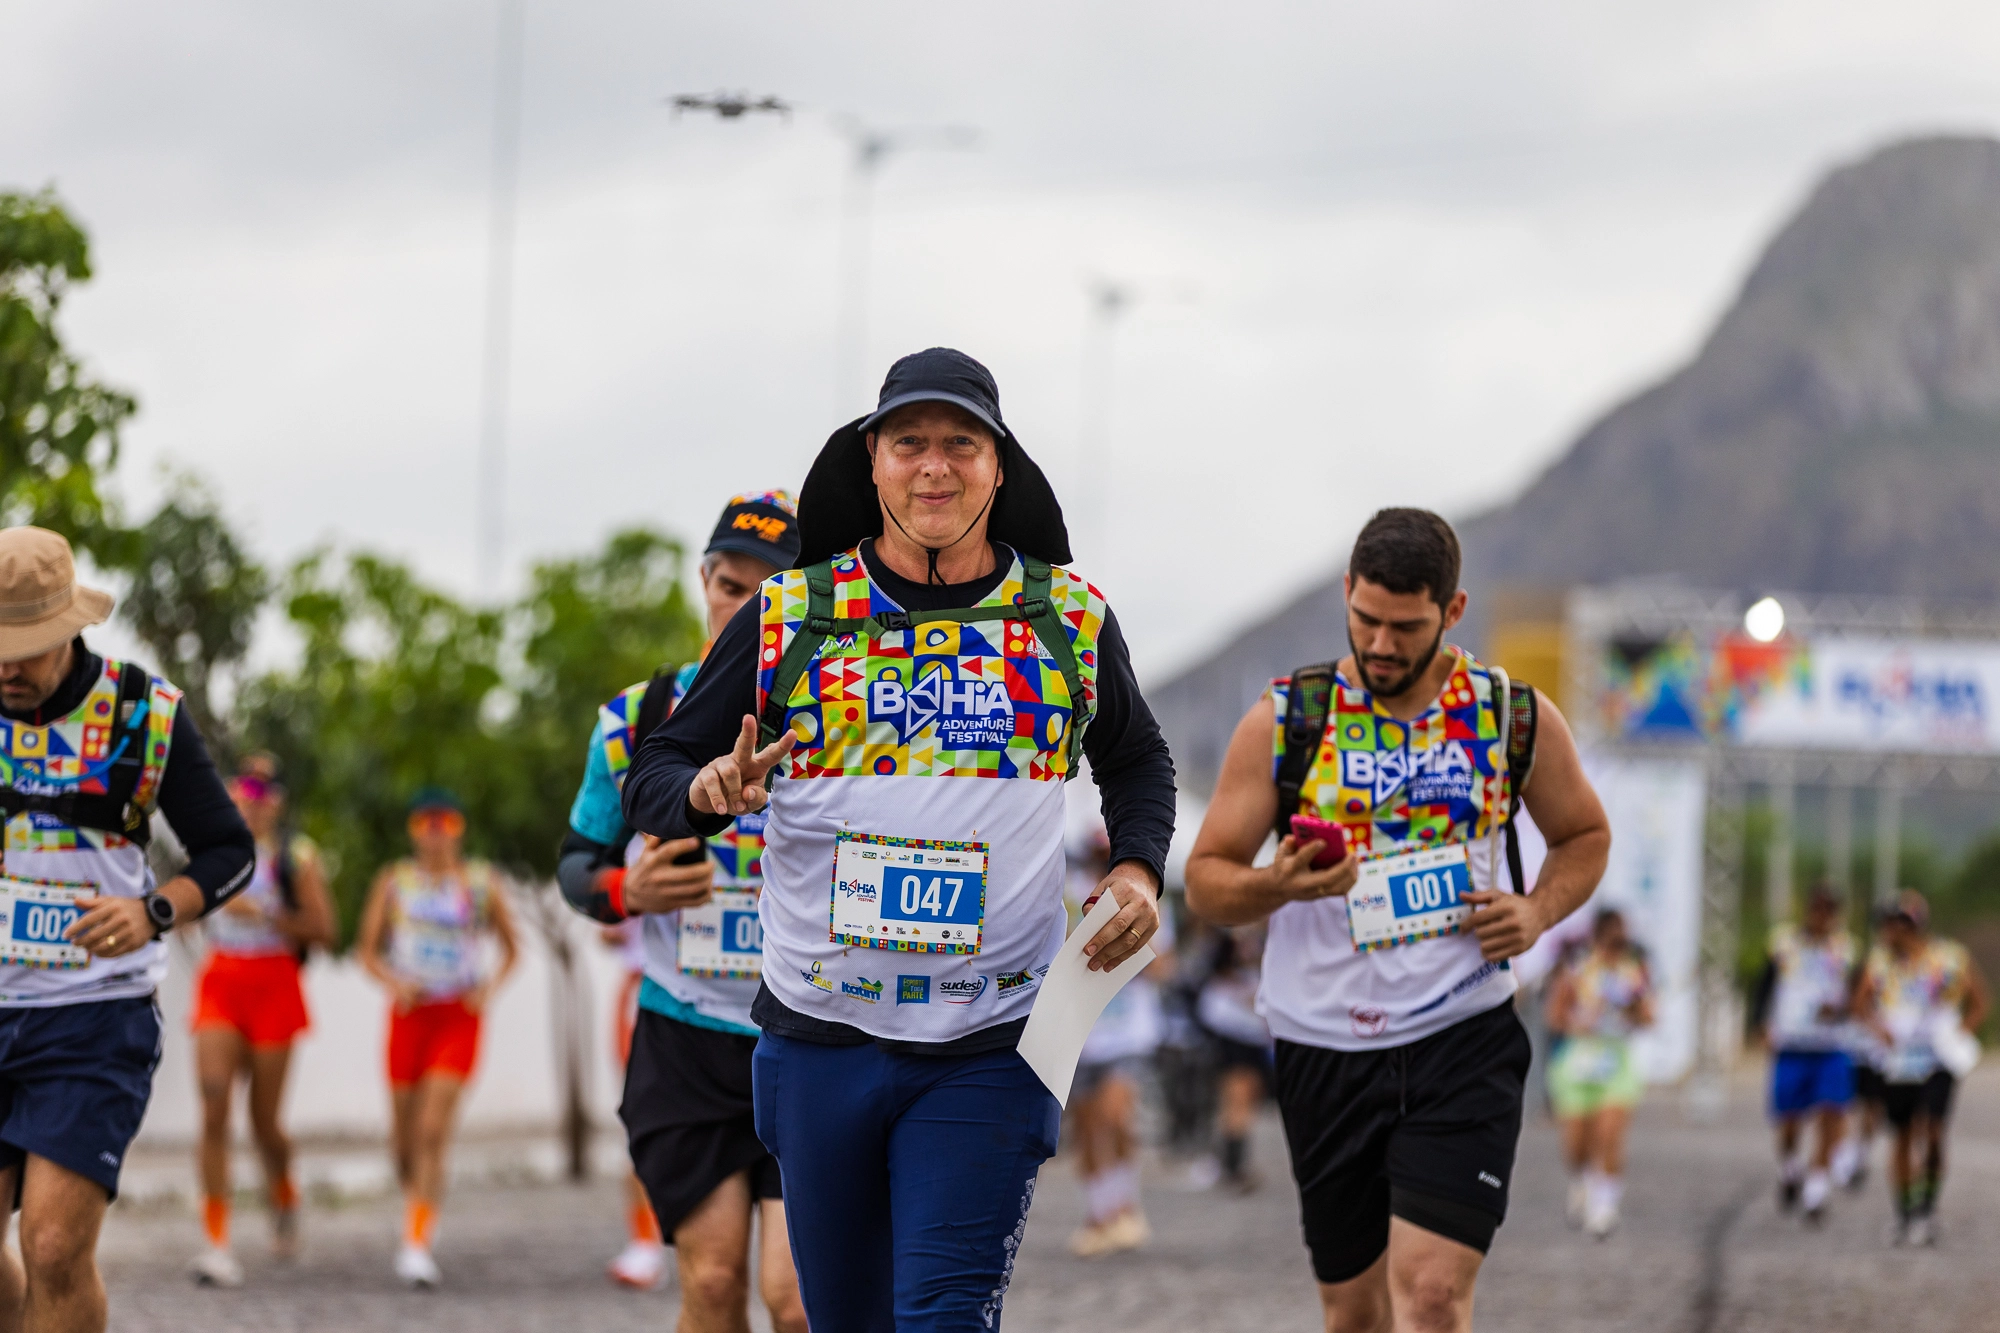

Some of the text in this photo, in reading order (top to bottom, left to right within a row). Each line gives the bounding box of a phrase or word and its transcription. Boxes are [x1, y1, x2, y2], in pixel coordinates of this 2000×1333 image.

[942, 717, 1014, 731] ADVENTURE
[900, 875, 964, 917] 047
[1405, 869, 1456, 911] 001
[940, 979, 982, 990] sudesb
